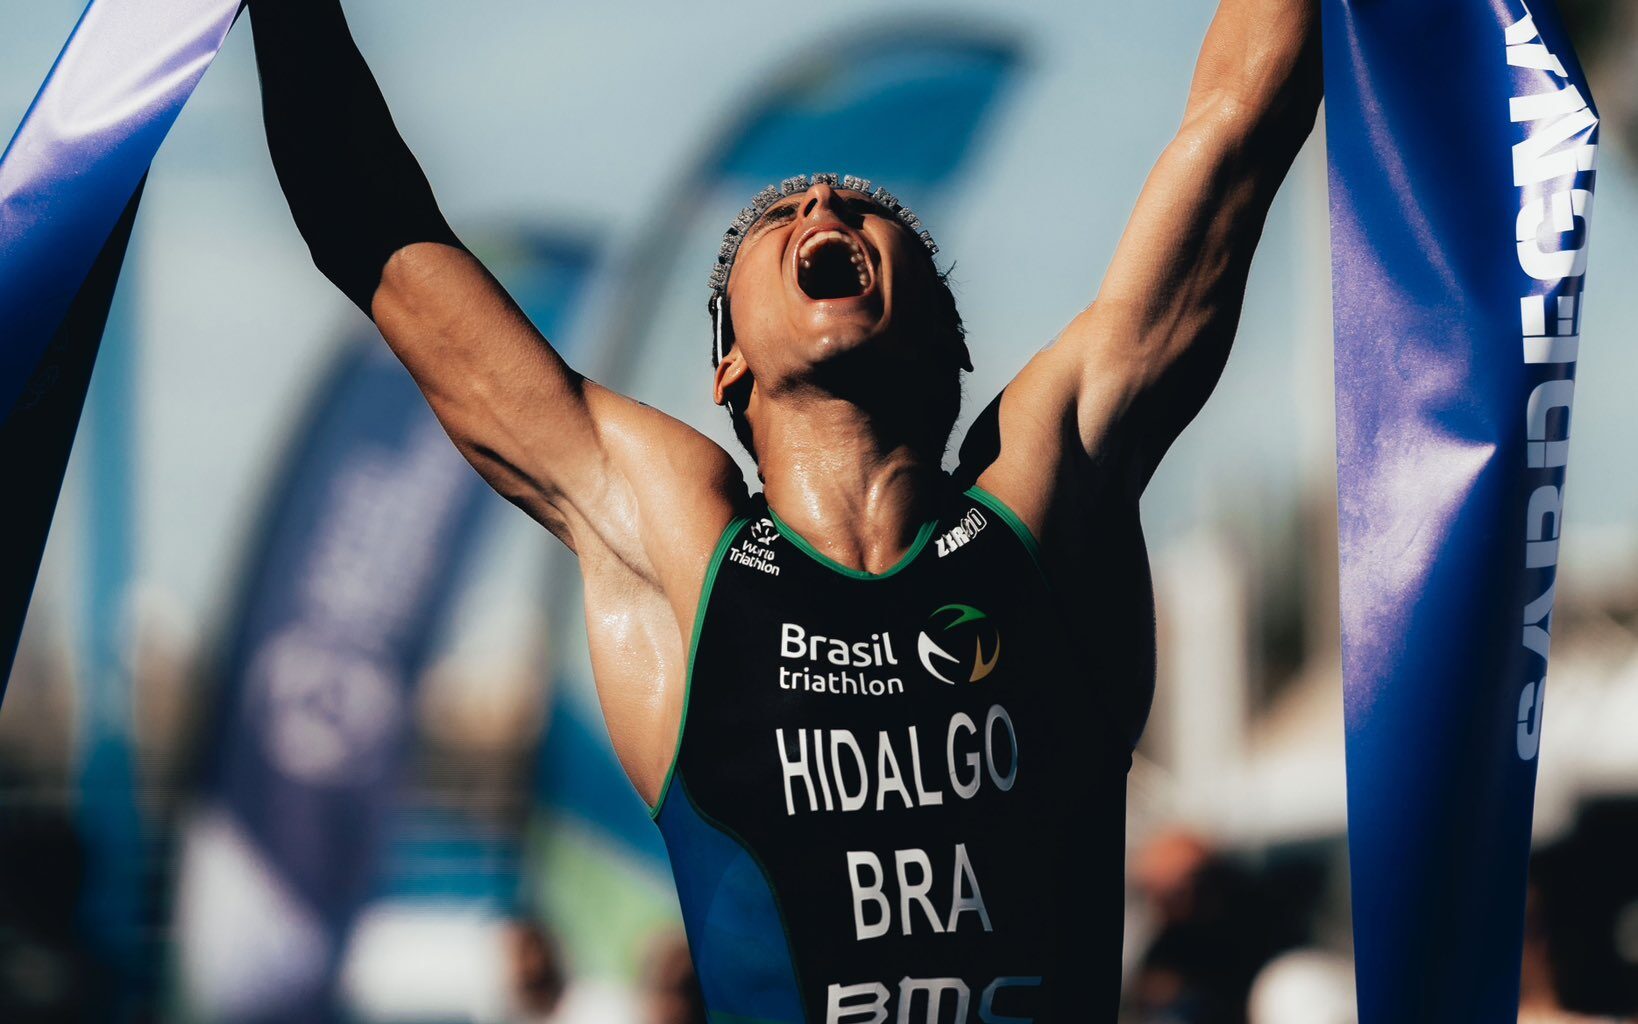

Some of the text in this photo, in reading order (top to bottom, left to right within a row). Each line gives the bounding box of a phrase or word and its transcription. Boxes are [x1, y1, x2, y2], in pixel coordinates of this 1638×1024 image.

[729, 547, 780, 577] Triathlon
[780, 622, 898, 667] Brasil
[779, 665, 904, 696] triathlon
[775, 704, 1018, 816] HIDALGO
[846, 842, 993, 941] BRA
[825, 975, 1043, 1024] BMC
